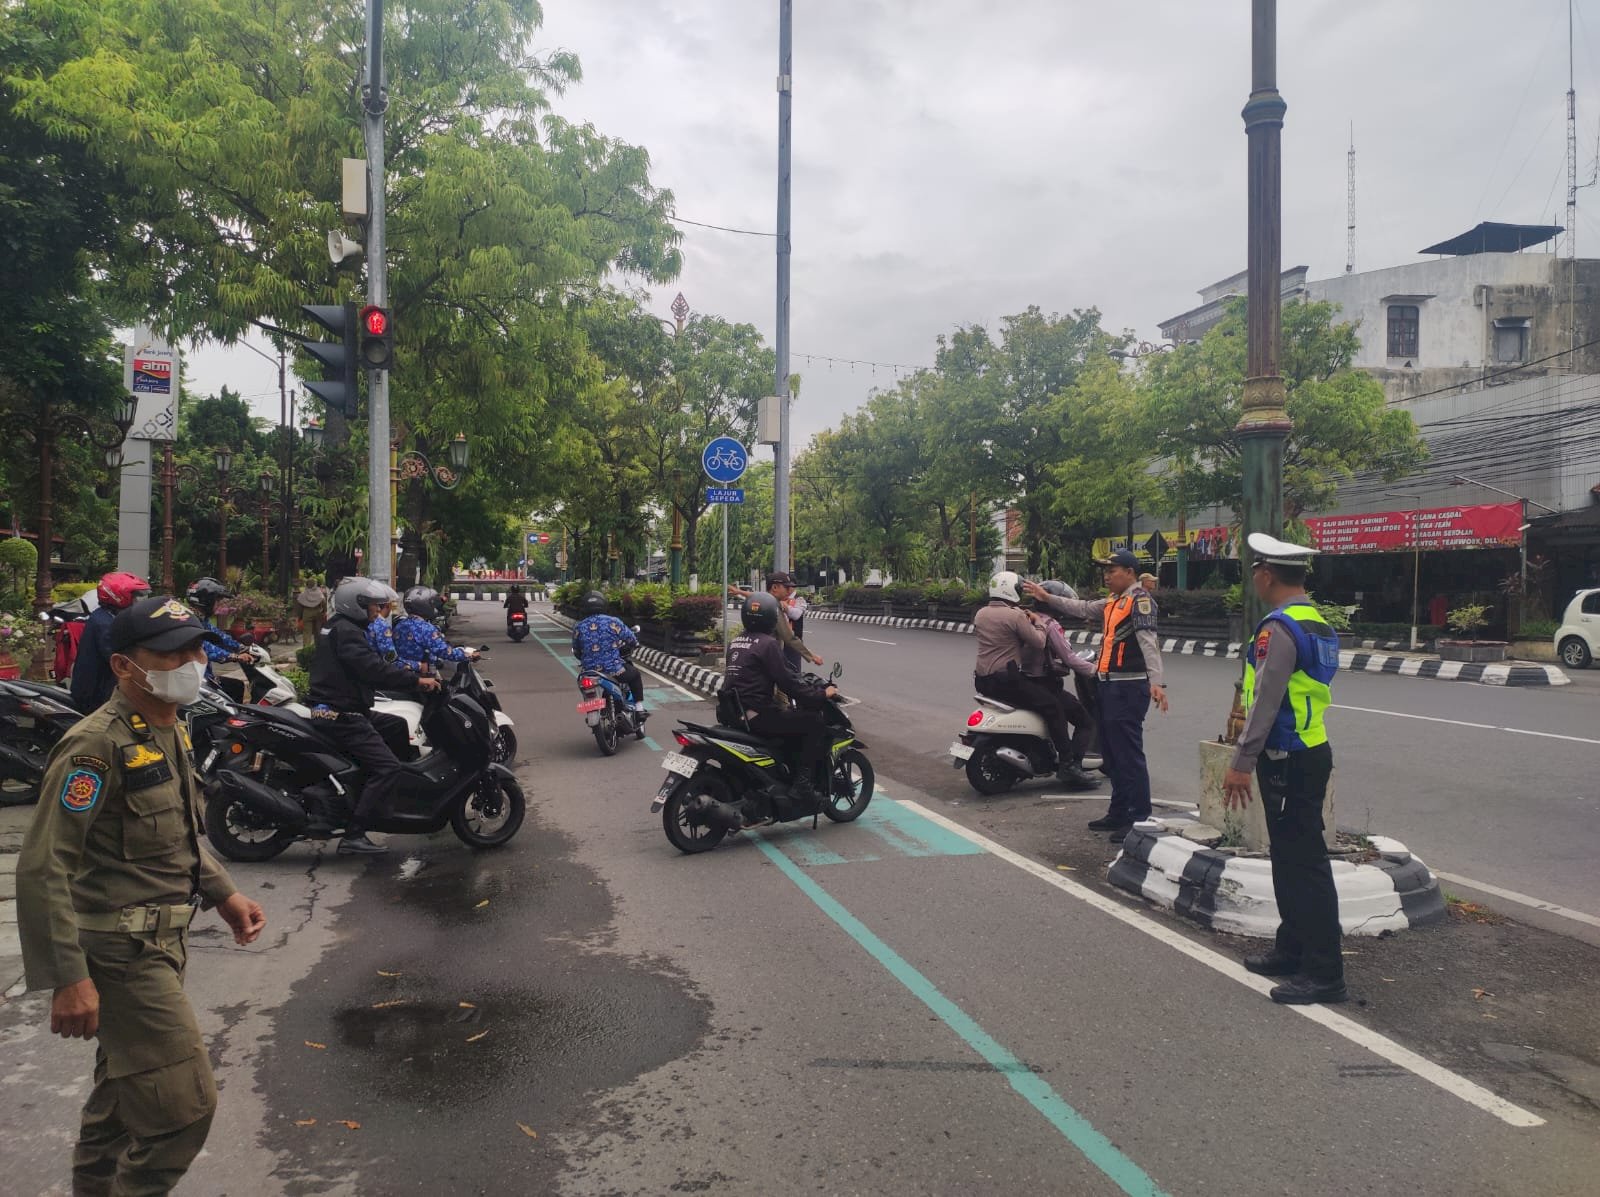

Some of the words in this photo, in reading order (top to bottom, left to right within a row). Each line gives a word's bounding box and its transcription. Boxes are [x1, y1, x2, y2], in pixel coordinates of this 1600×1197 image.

[142, 361, 170, 371] atm
[1411, 513, 1437, 521] CLANA
[1438, 511, 1462, 519] CASUAL
[1337, 519, 1354, 527] BATIK
[1411, 522, 1433, 530] AEKA
[1382, 524, 1401, 532] STORE
[1411, 530, 1442, 538] SRAGAM
[1443, 529, 1474, 537] SEKOLAH
